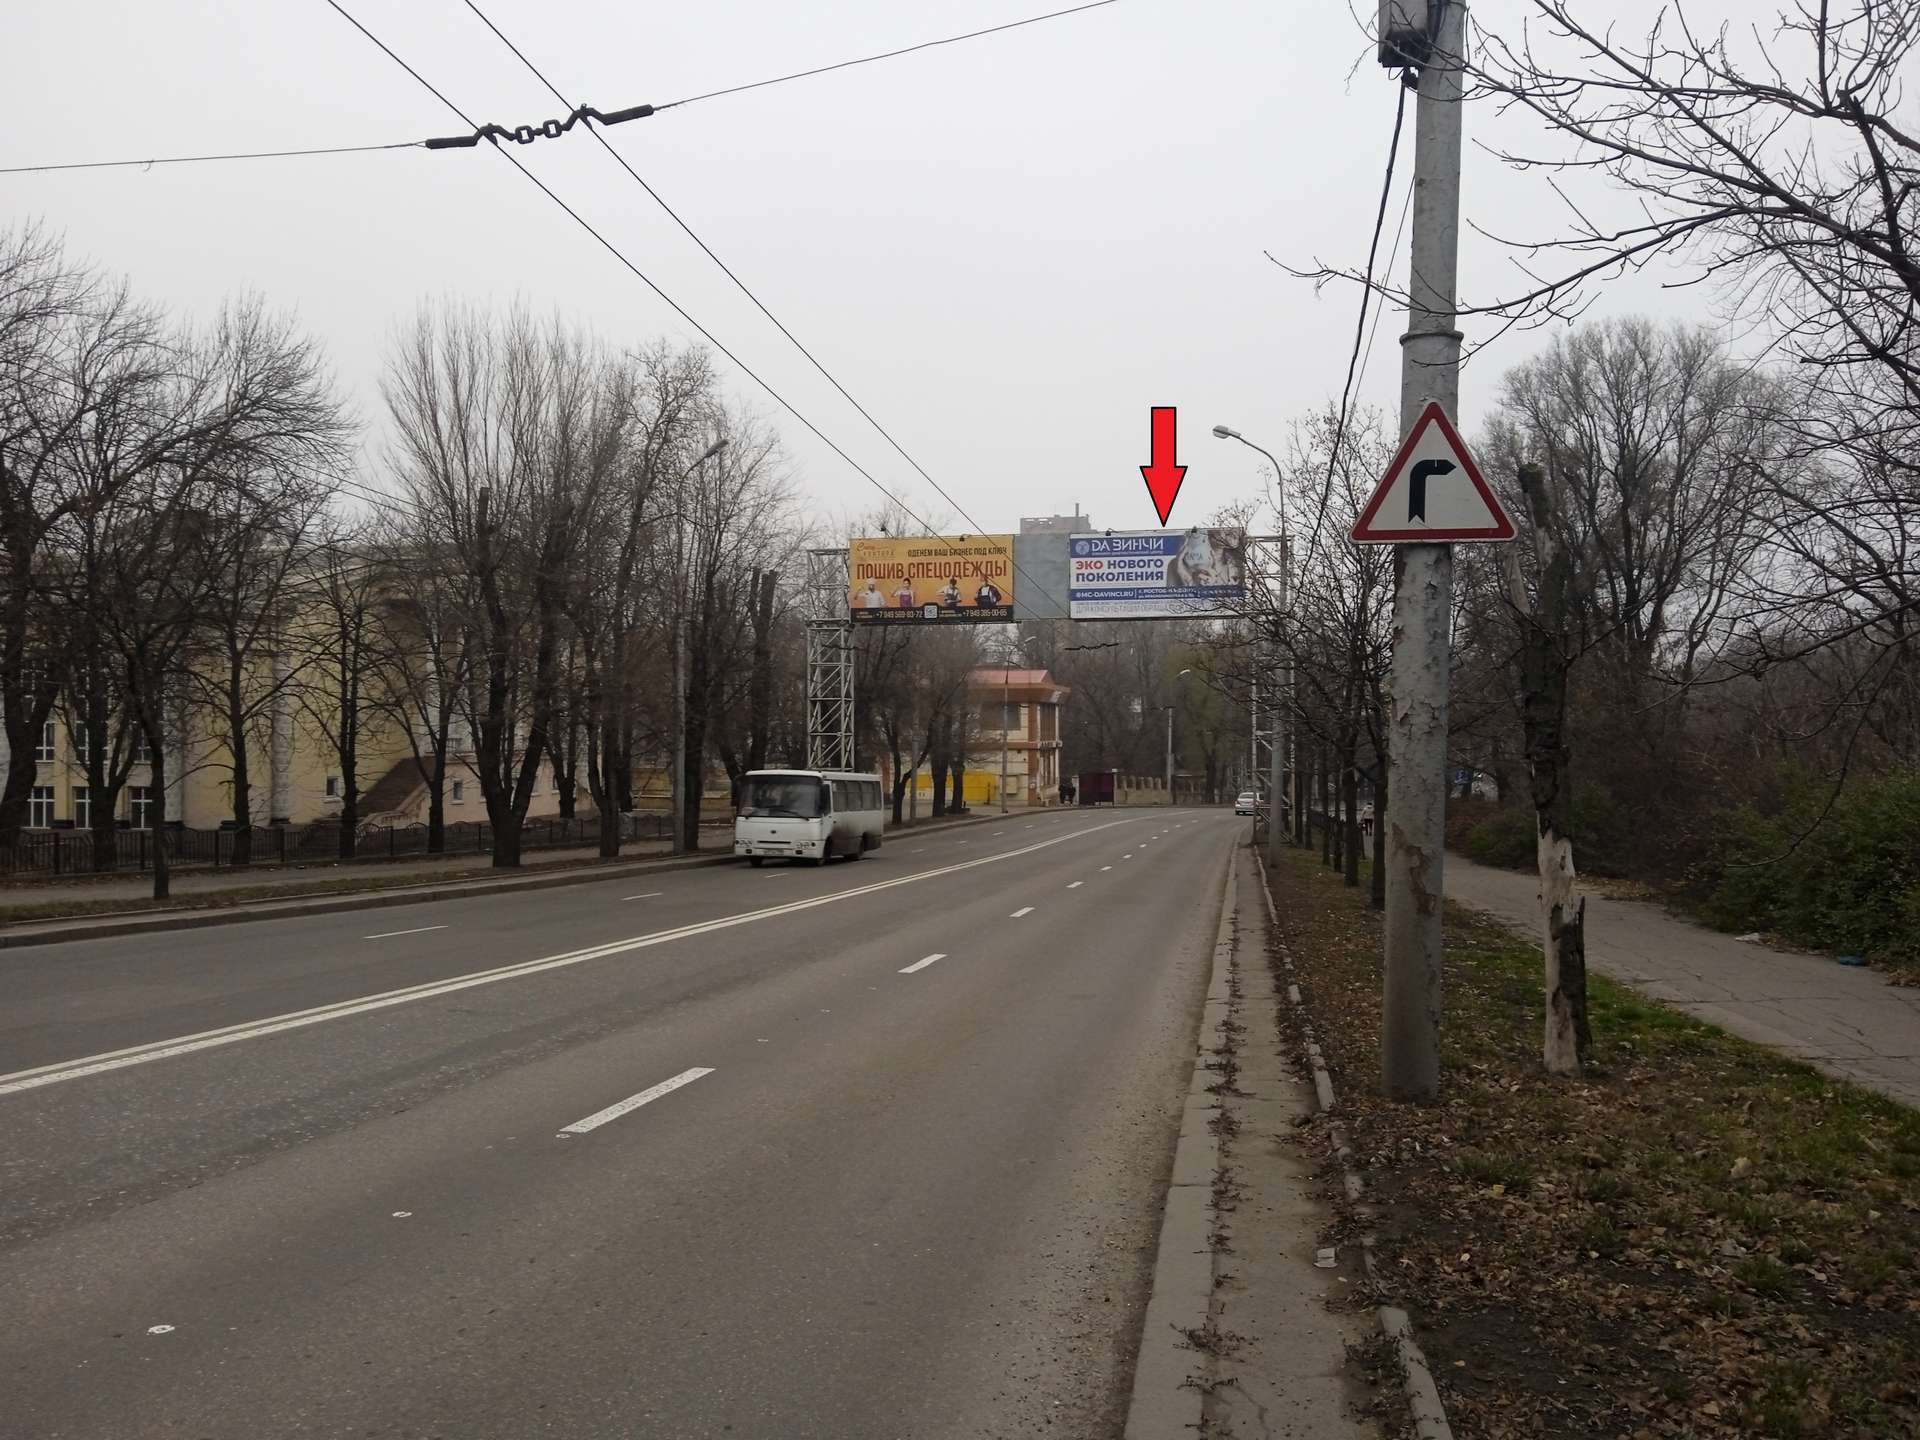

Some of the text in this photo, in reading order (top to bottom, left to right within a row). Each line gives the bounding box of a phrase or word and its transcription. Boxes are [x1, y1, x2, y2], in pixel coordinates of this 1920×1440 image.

[934, 548, 948, 557] ВАШ
[1076, 558, 1164, 570] ЭКО НОВОГО
[856, 560, 1008, 580] ПОШИВ СПЕЦОДЕЖДЫ
[1076, 571, 1164, 582] ПОКОЛЕНИЯ
